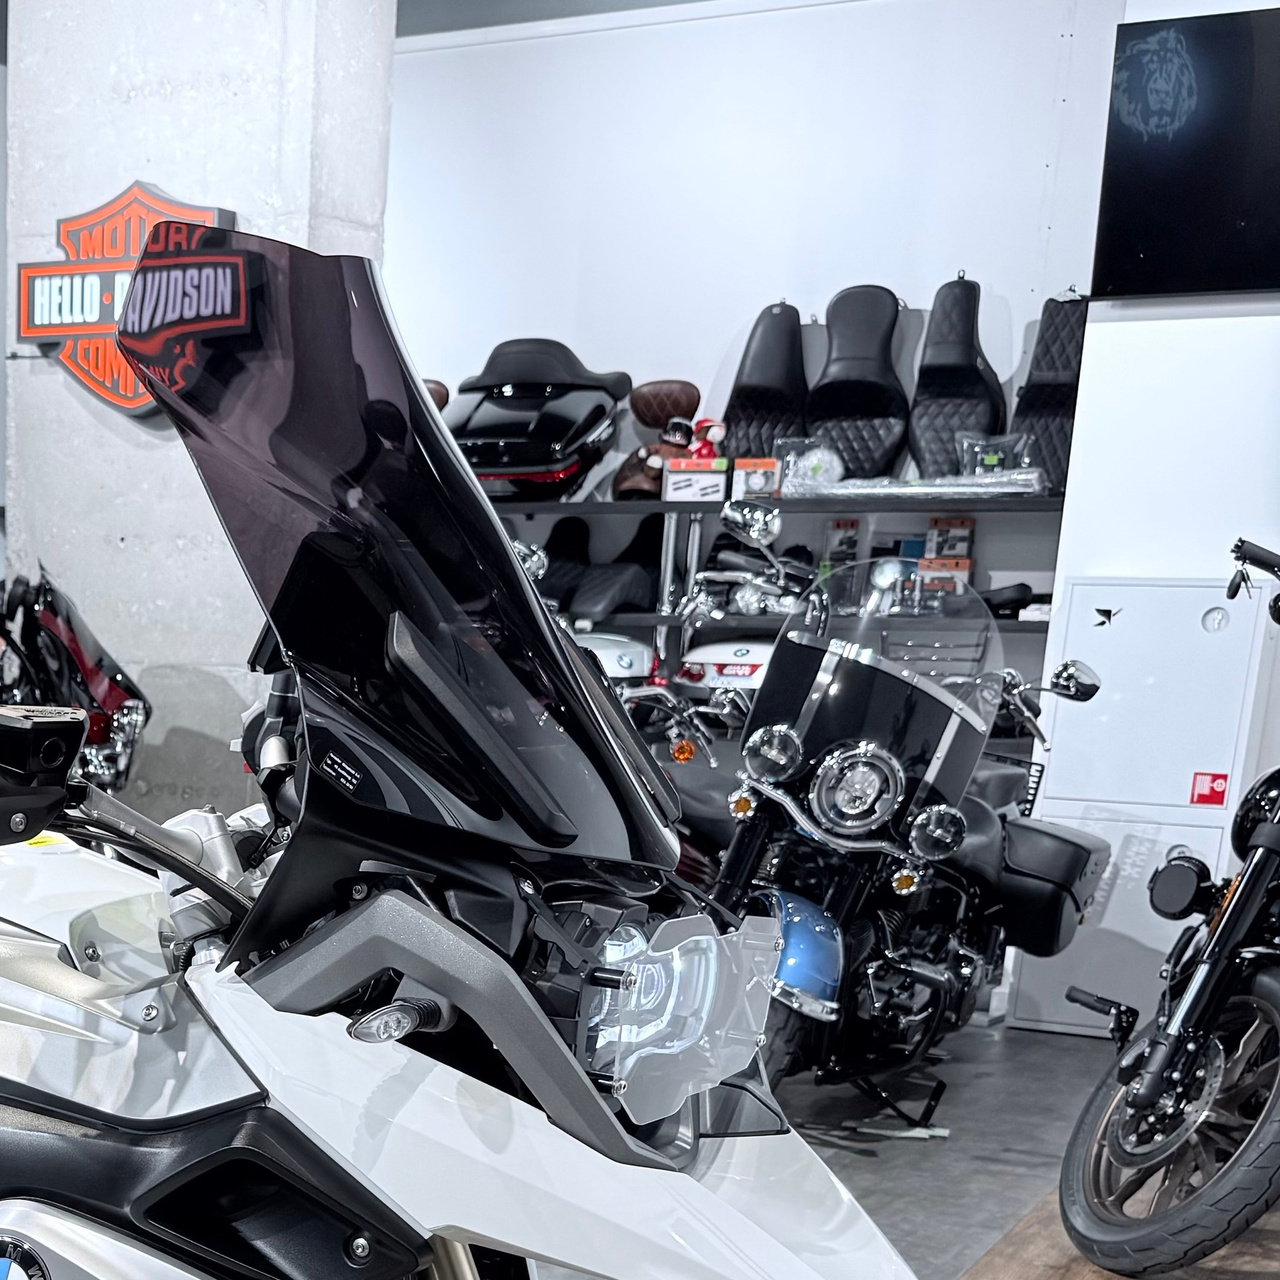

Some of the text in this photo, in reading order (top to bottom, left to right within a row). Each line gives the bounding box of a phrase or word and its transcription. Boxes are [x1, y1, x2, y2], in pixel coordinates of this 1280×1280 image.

[80, 203, 188, 259] MOTOR
[34, 267, 232, 334] HELLO DAVIDSON
